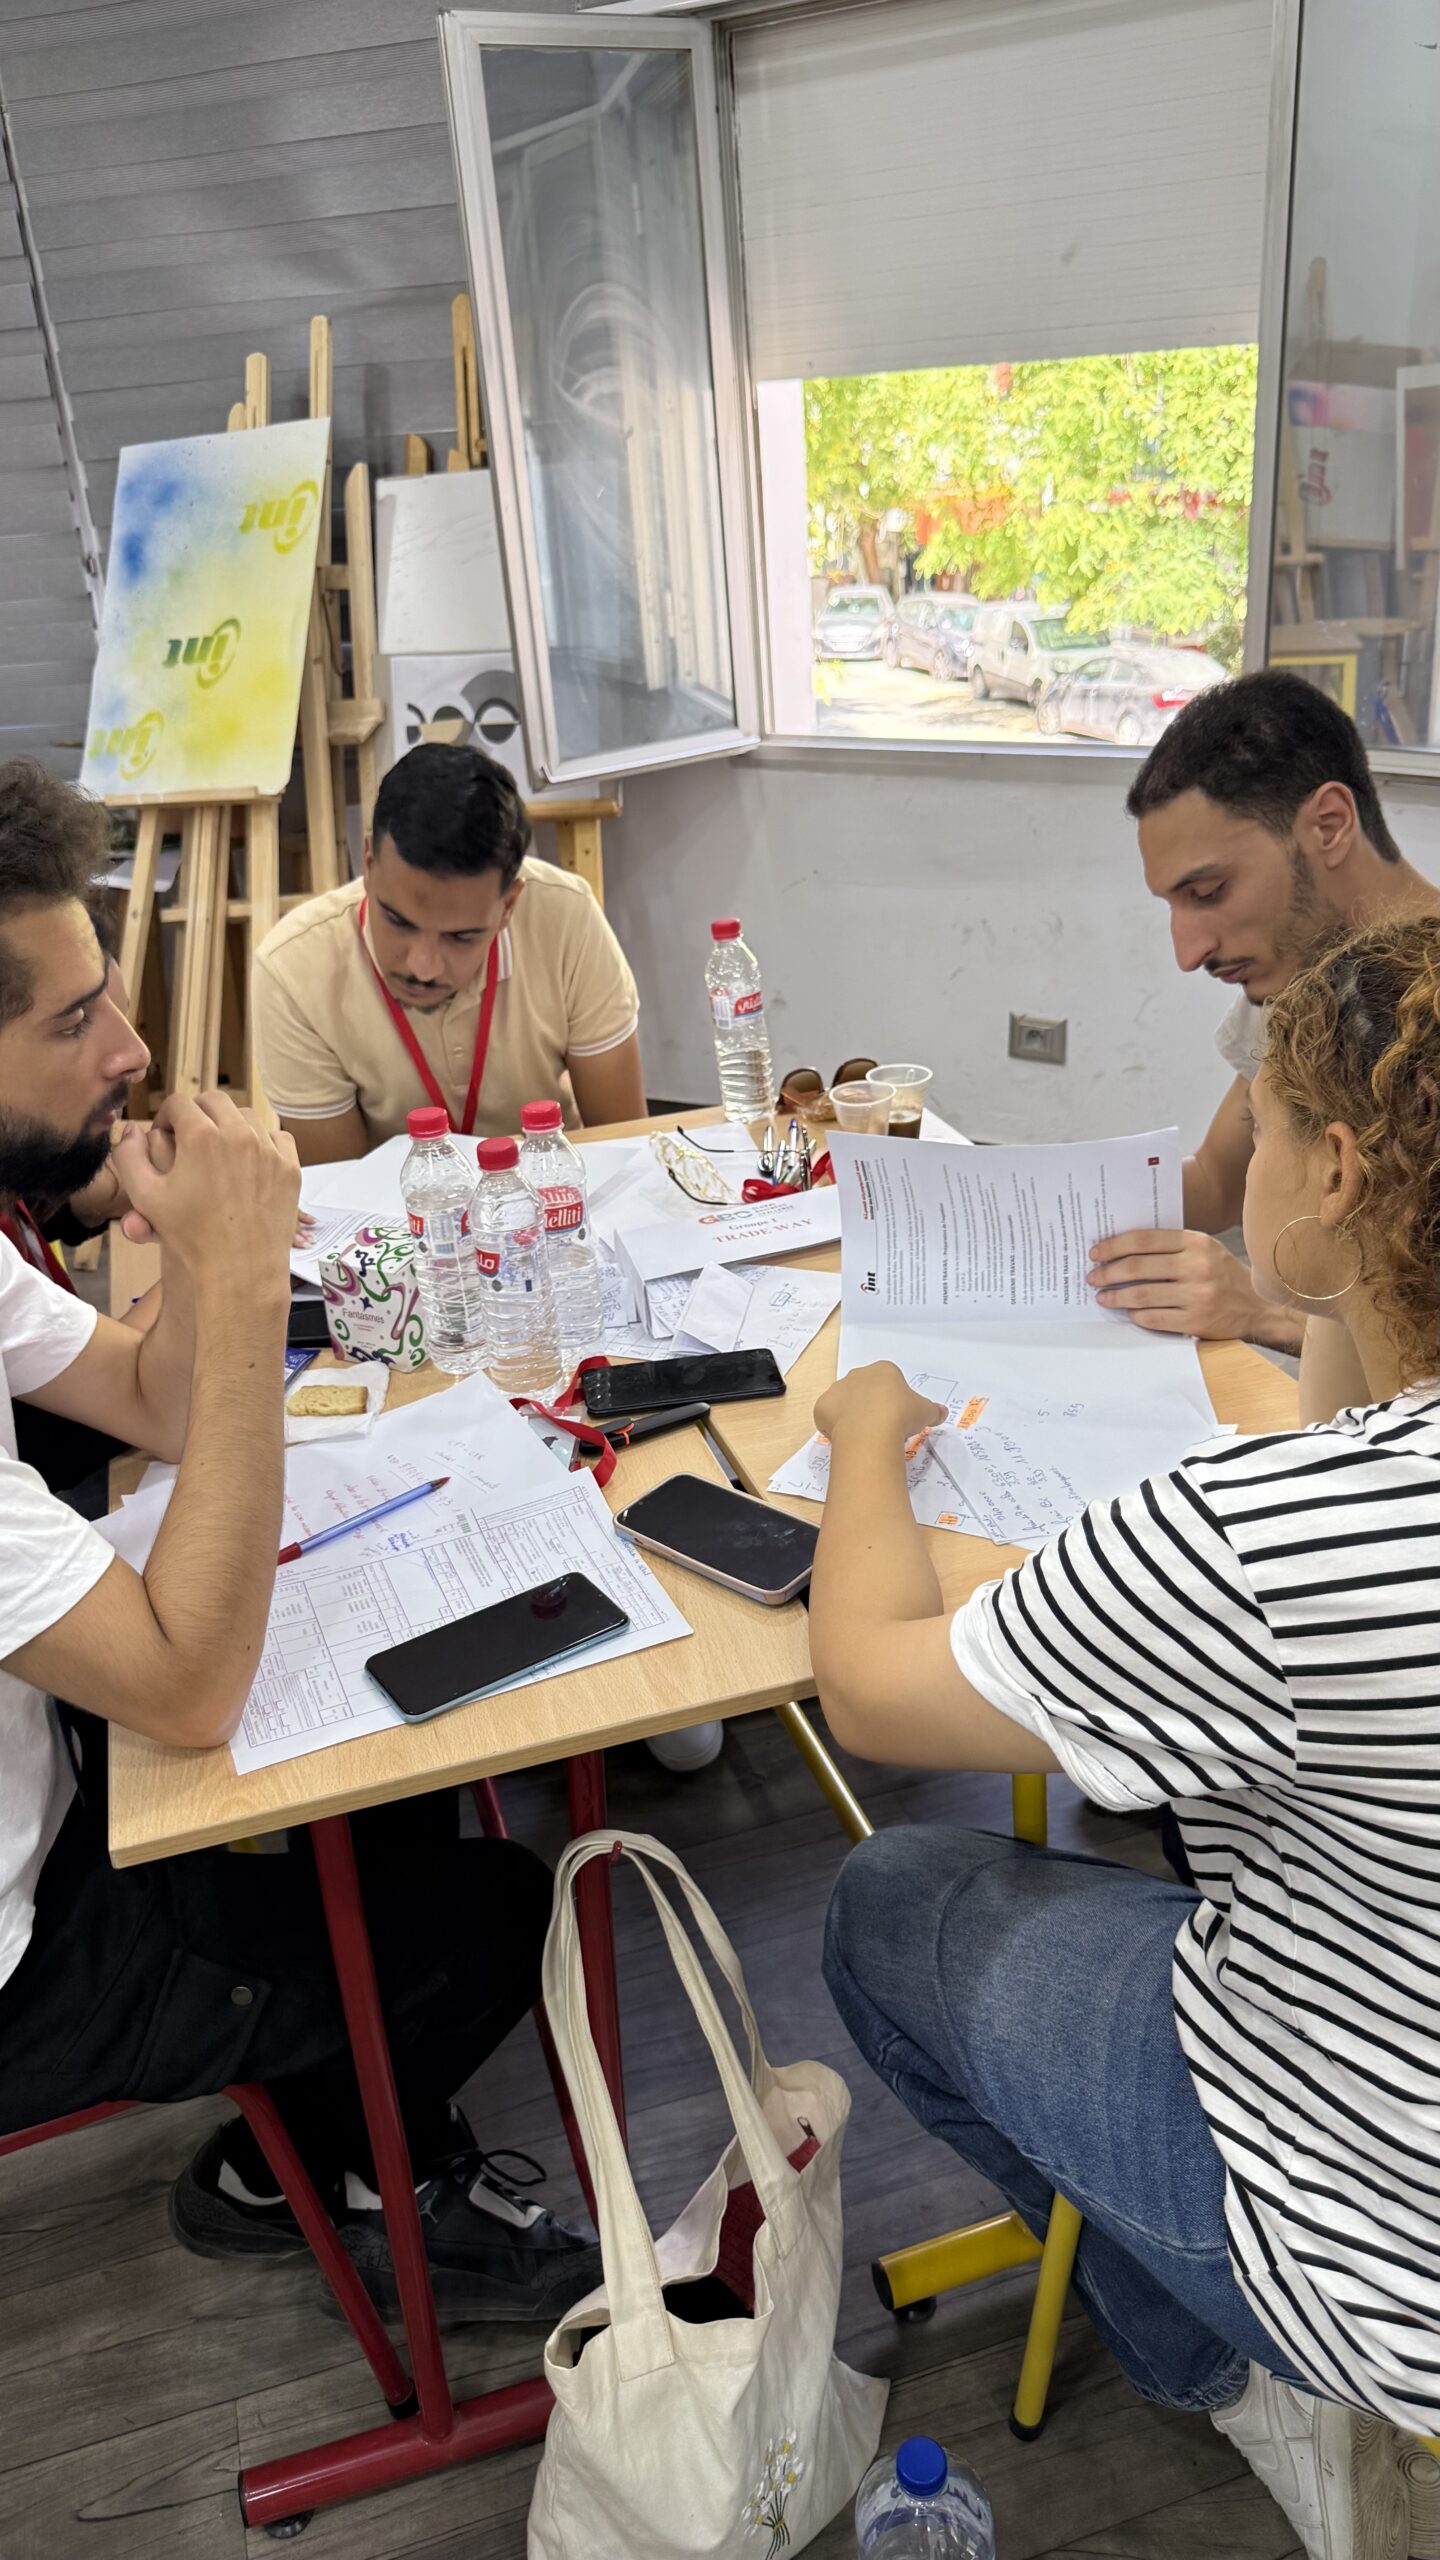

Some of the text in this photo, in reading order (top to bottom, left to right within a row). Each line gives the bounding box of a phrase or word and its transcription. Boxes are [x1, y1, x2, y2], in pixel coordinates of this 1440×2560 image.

[713, 1218, 813, 1243] TRADE WAY
[861, 1272, 878, 1294] int
[342, 1308, 385, 1324] Fantasmes
